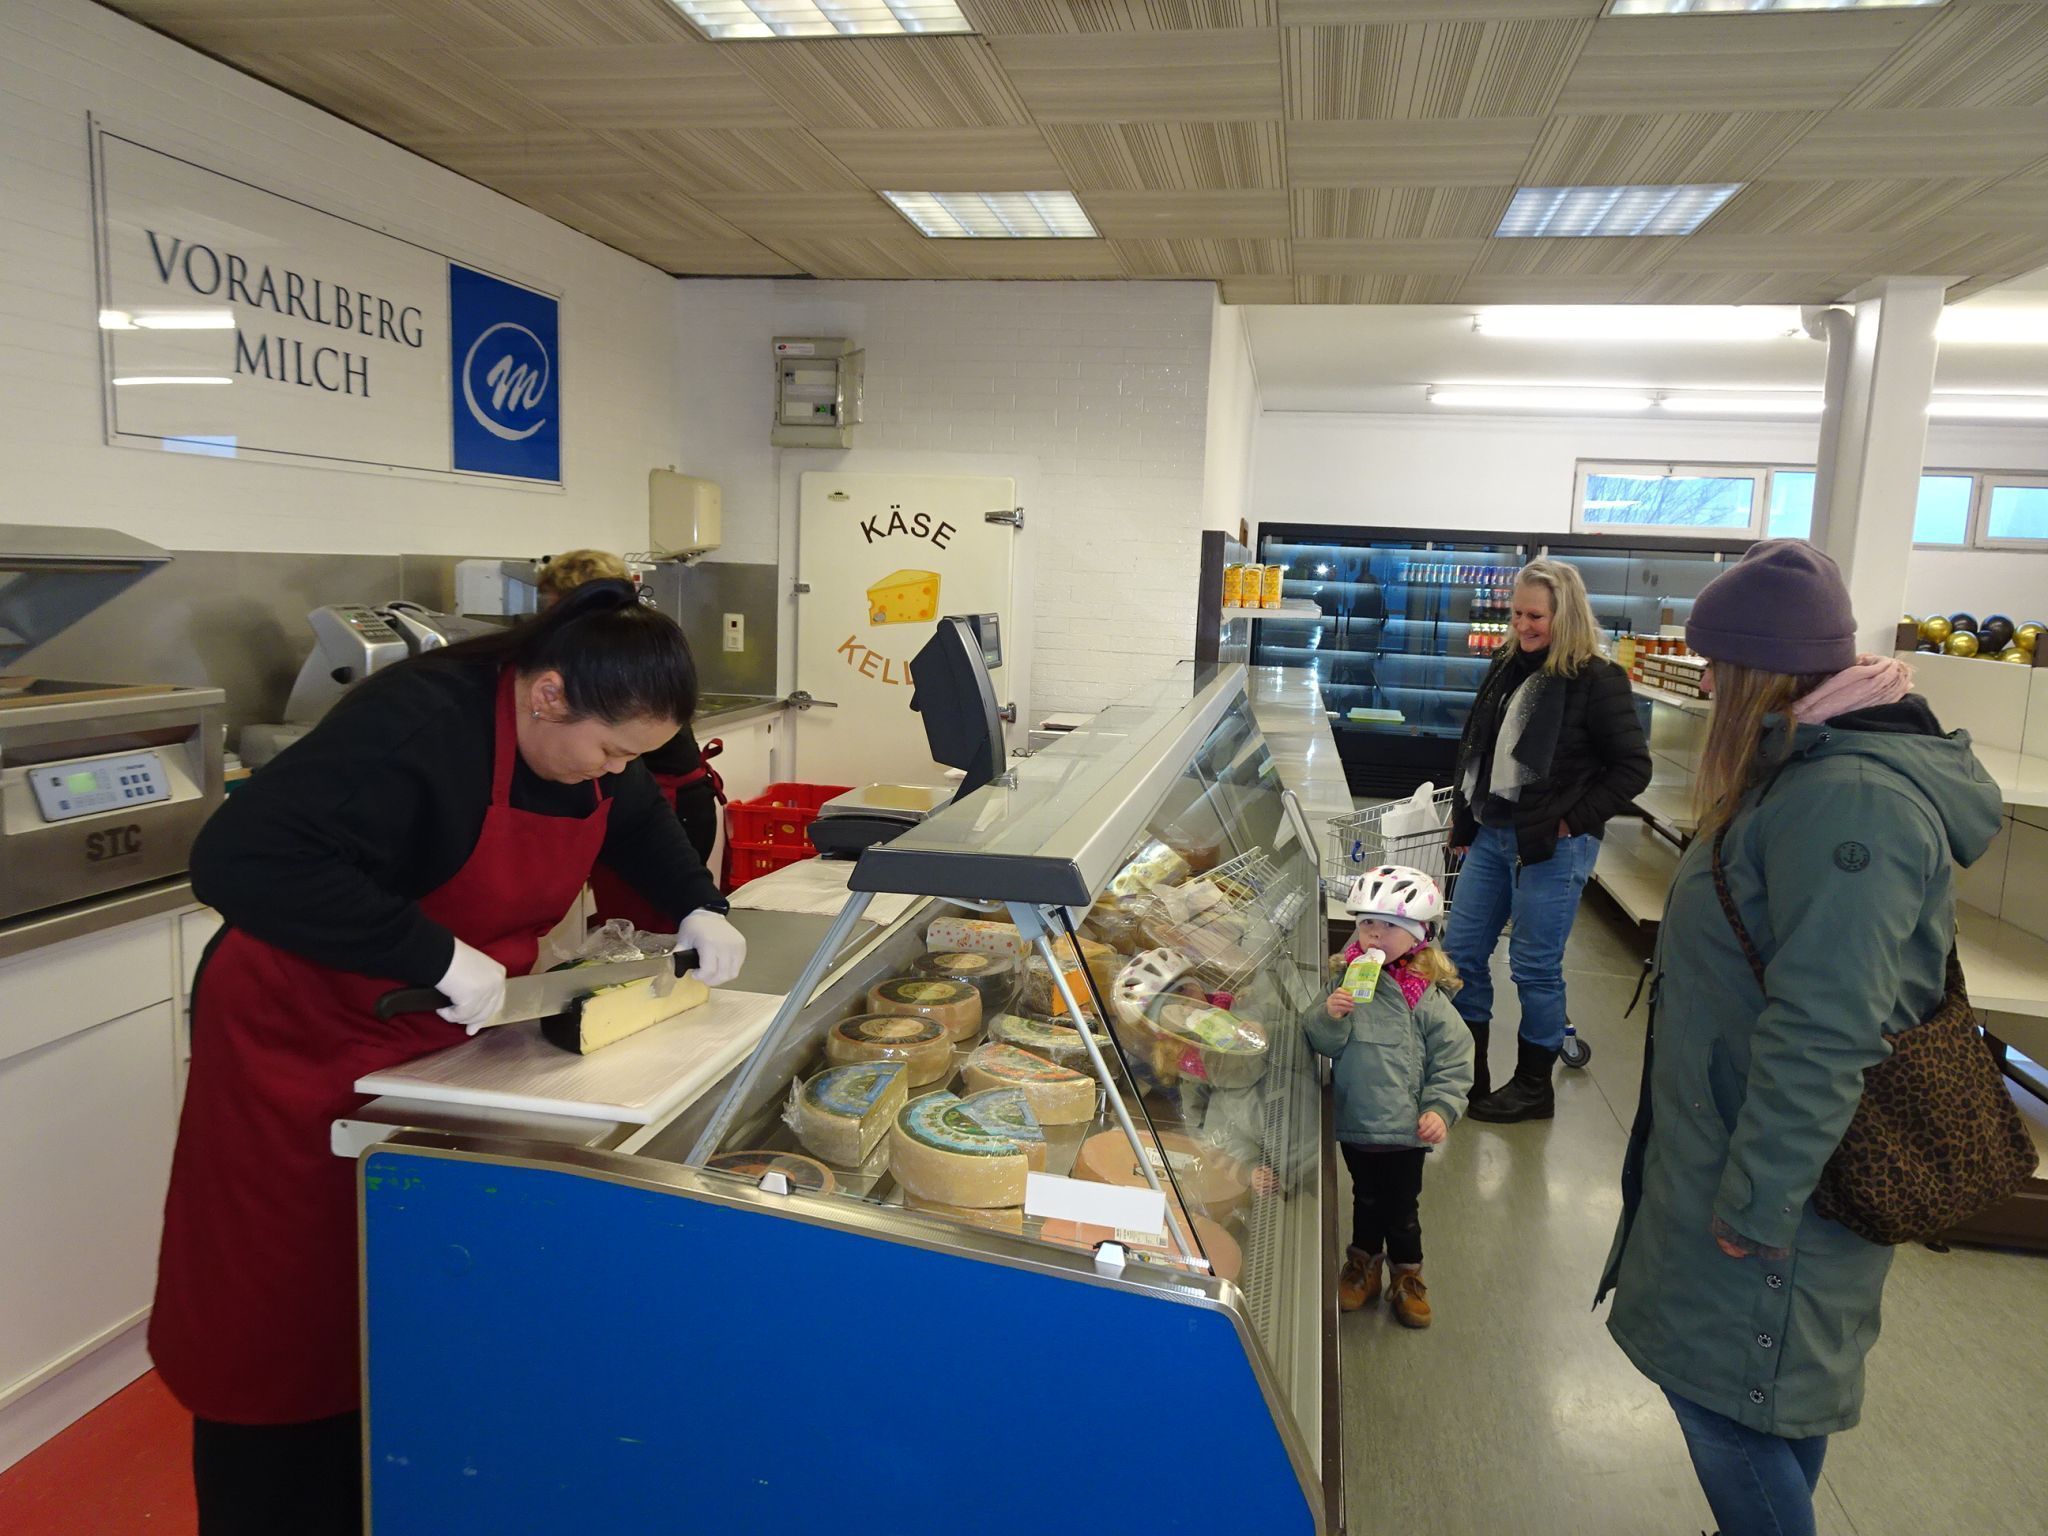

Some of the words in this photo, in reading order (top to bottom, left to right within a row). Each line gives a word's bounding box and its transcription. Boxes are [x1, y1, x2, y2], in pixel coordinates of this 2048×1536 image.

[145, 229, 424, 349] VORARLBERG
[234, 328, 371, 398] MILCH
[860, 504, 957, 551] KÄSE
[837, 634, 915, 687] KELL
[86, 824, 142, 861] STC
